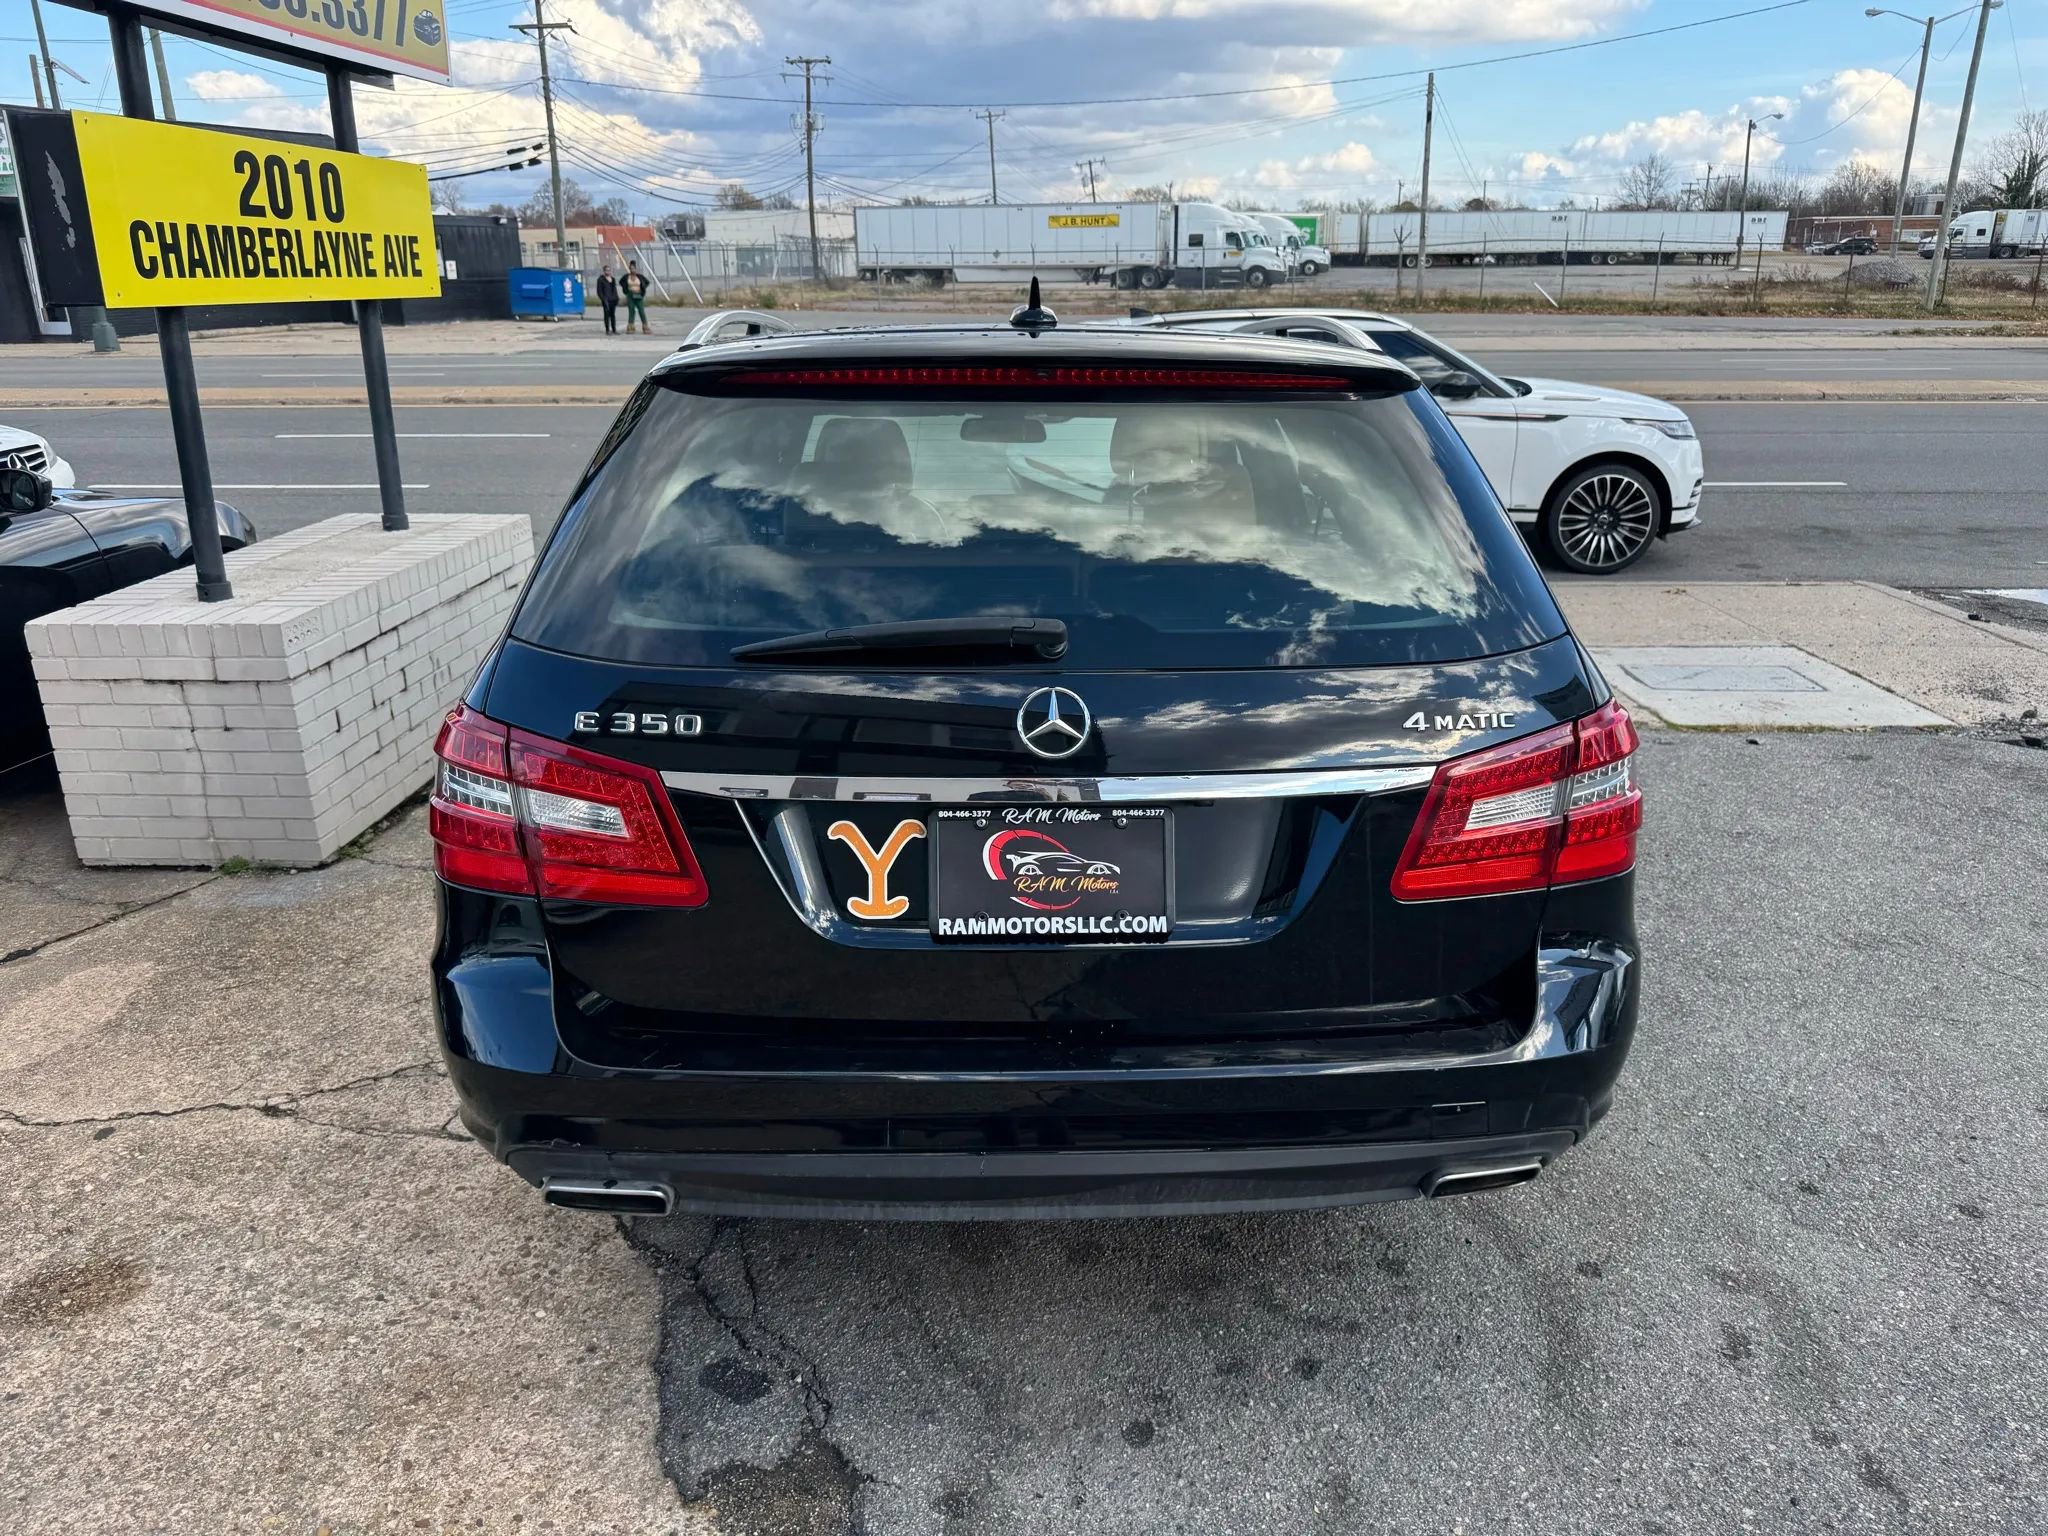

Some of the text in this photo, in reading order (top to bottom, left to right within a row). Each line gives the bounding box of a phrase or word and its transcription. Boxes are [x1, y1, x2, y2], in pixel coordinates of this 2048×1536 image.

[233, 150, 345, 223] 2010
[1080, 216, 1105, 226] HUNT
[129, 219, 423, 280] CHAMBERLAYNE AVE
[574, 711, 702, 735] E 350
[1402, 711, 1516, 732] 4 MATIC
[938, 810, 991, 818] 804-466-3377
[1002, 807, 1102, 824] RAM Motors
[1112, 809, 1165, 817] 804-466-3377
[827, 818, 928, 919] Y
[1013, 876, 1119, 893] RAM Motors
[938, 915, 1168, 936] RAMMOTORSLLC.COM
